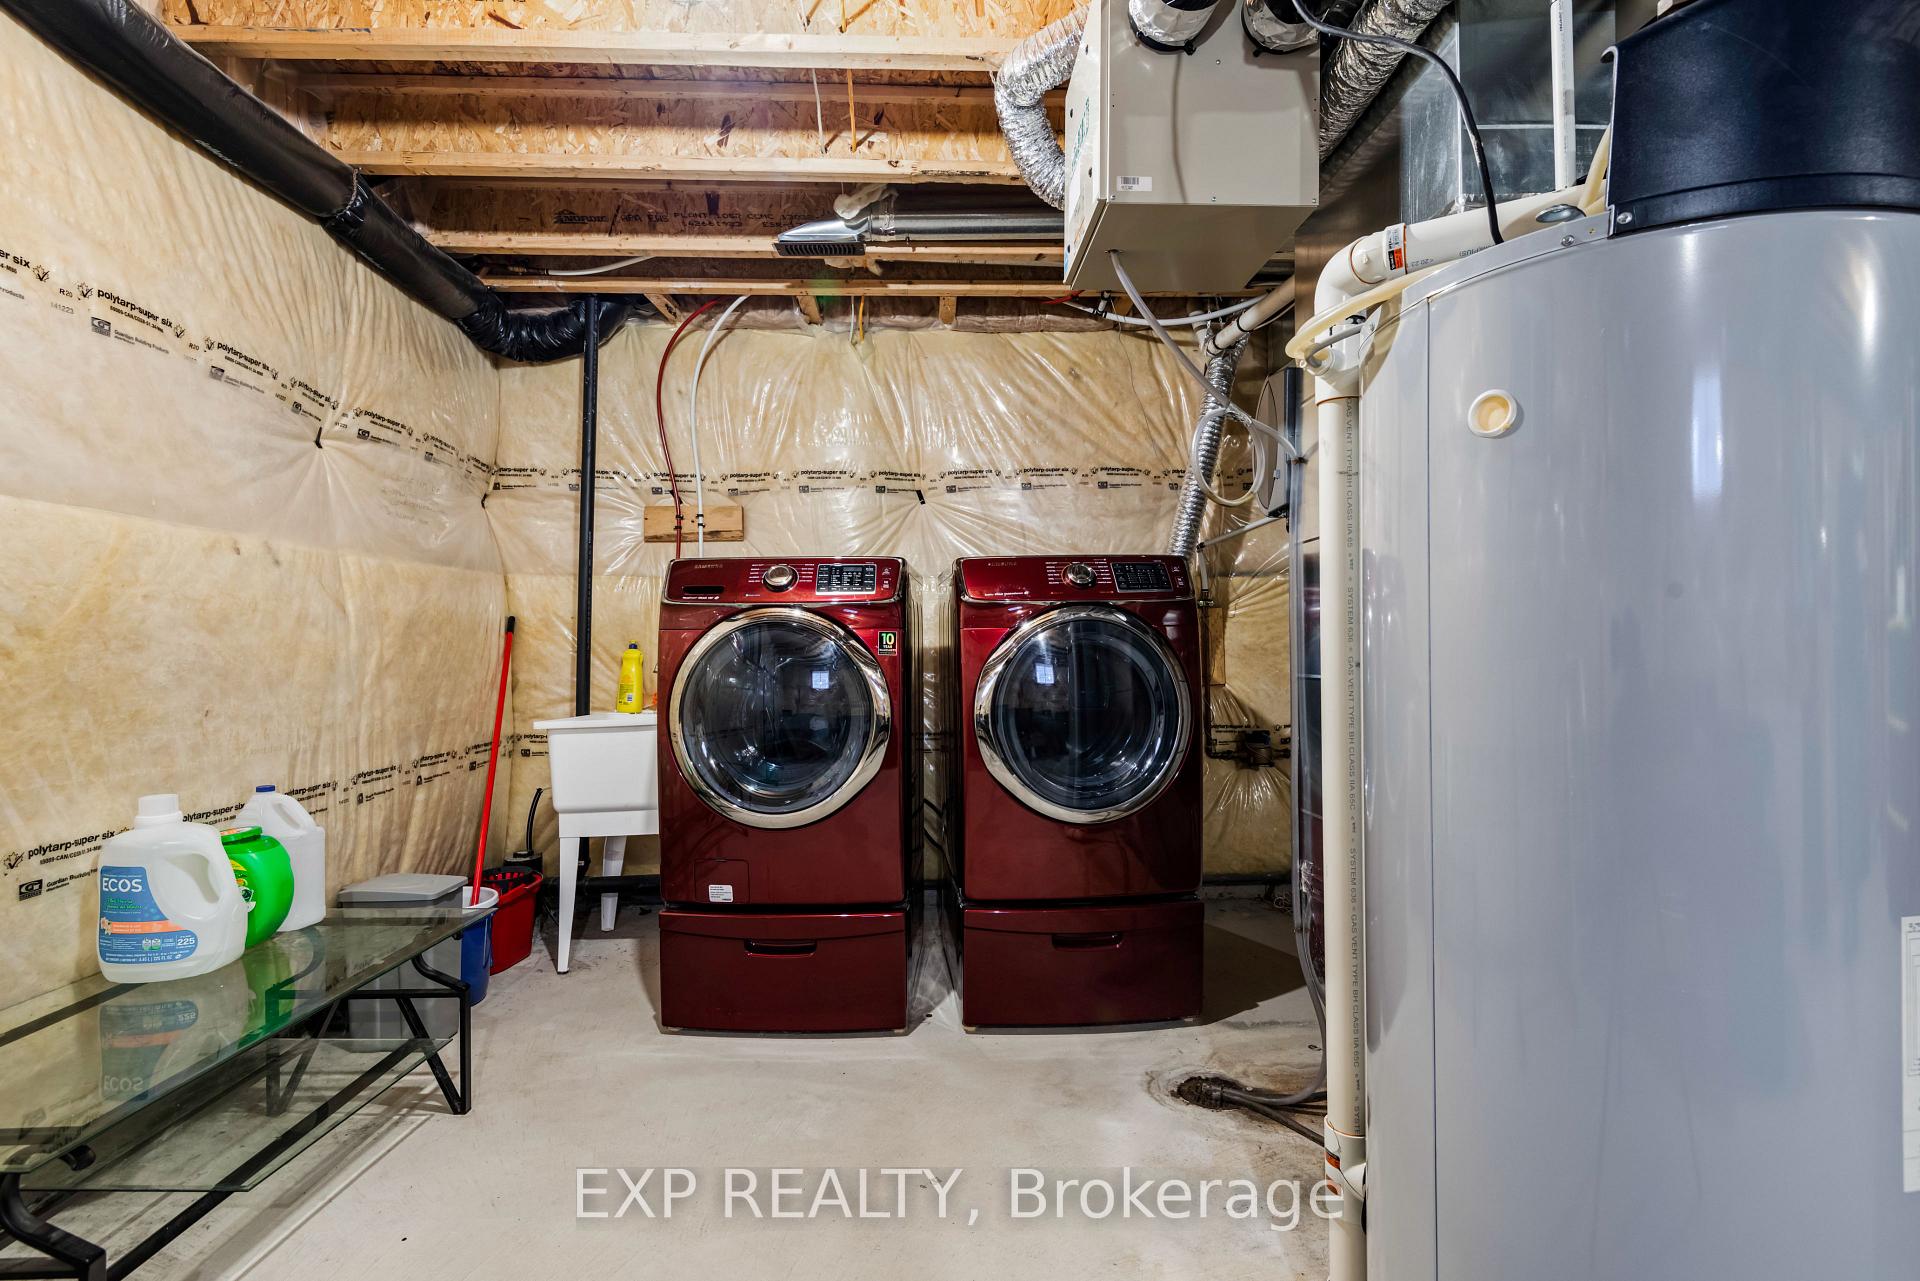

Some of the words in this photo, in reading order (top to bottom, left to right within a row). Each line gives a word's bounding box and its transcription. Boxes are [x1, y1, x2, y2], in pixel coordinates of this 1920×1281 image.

[13, 255, 31, 268] six
[97, 289, 160, 322] polytarp-super
[161, 317, 173, 329] six
[881, 633, 895, 645] 10
[1348, 731, 1355, 744] BH
[182, 806, 234, 823] olytarp-super
[28, 834, 99, 860] polytarp-super
[101, 829, 115, 840] six
[102, 877, 143, 893] ECOS
[177, 937, 195, 946] 225
[1352, 989, 1359, 1002] BH
[1353, 1105, 1361, 1136] SYSTE
